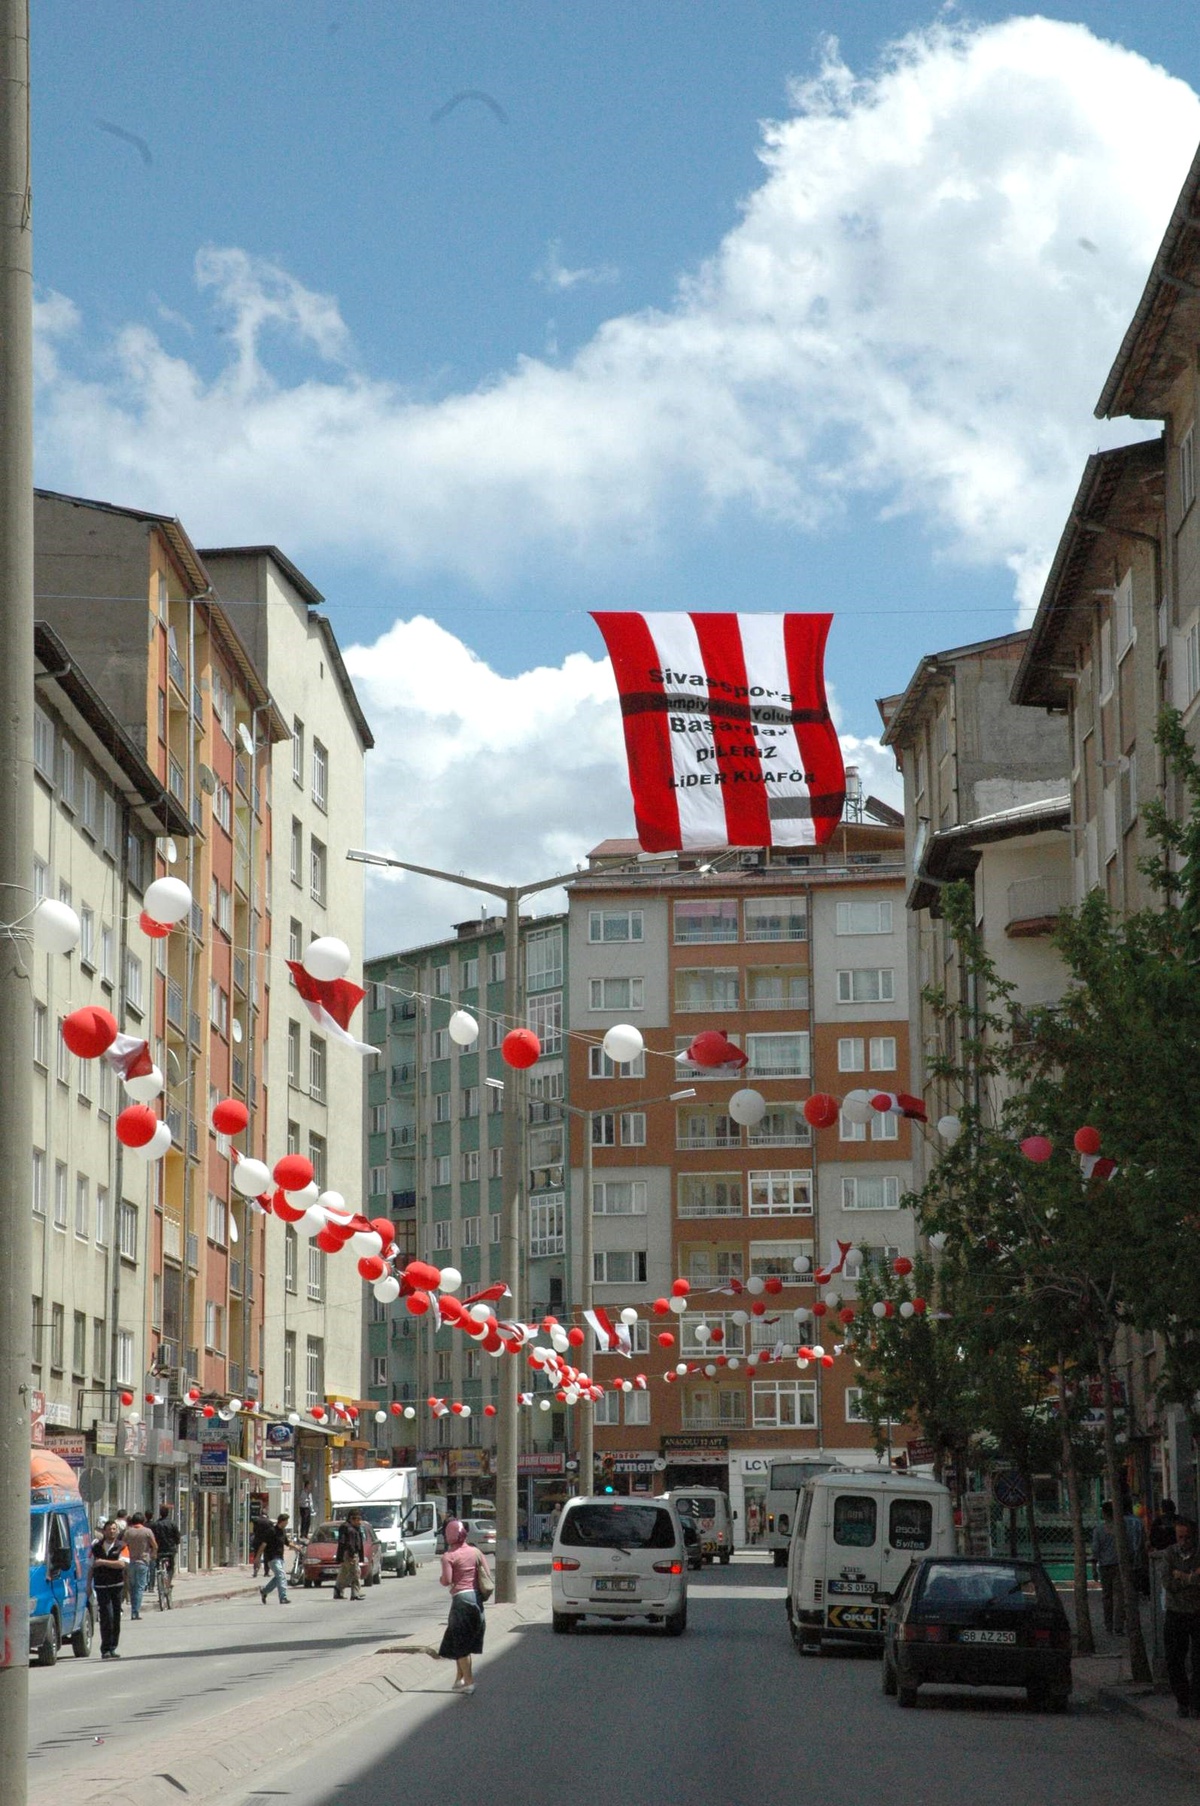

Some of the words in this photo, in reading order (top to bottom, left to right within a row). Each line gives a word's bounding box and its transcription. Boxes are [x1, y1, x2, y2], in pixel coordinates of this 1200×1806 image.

[648, 668, 795, 702] Sivasspor'a
[856, 1584, 875, 1592] 0155
[842, 1613, 876, 1622] OKUL
[964, 1632, 976, 1641] 58
[980, 1632, 995, 1642] AZ
[996, 1633, 1015, 1643] 250
